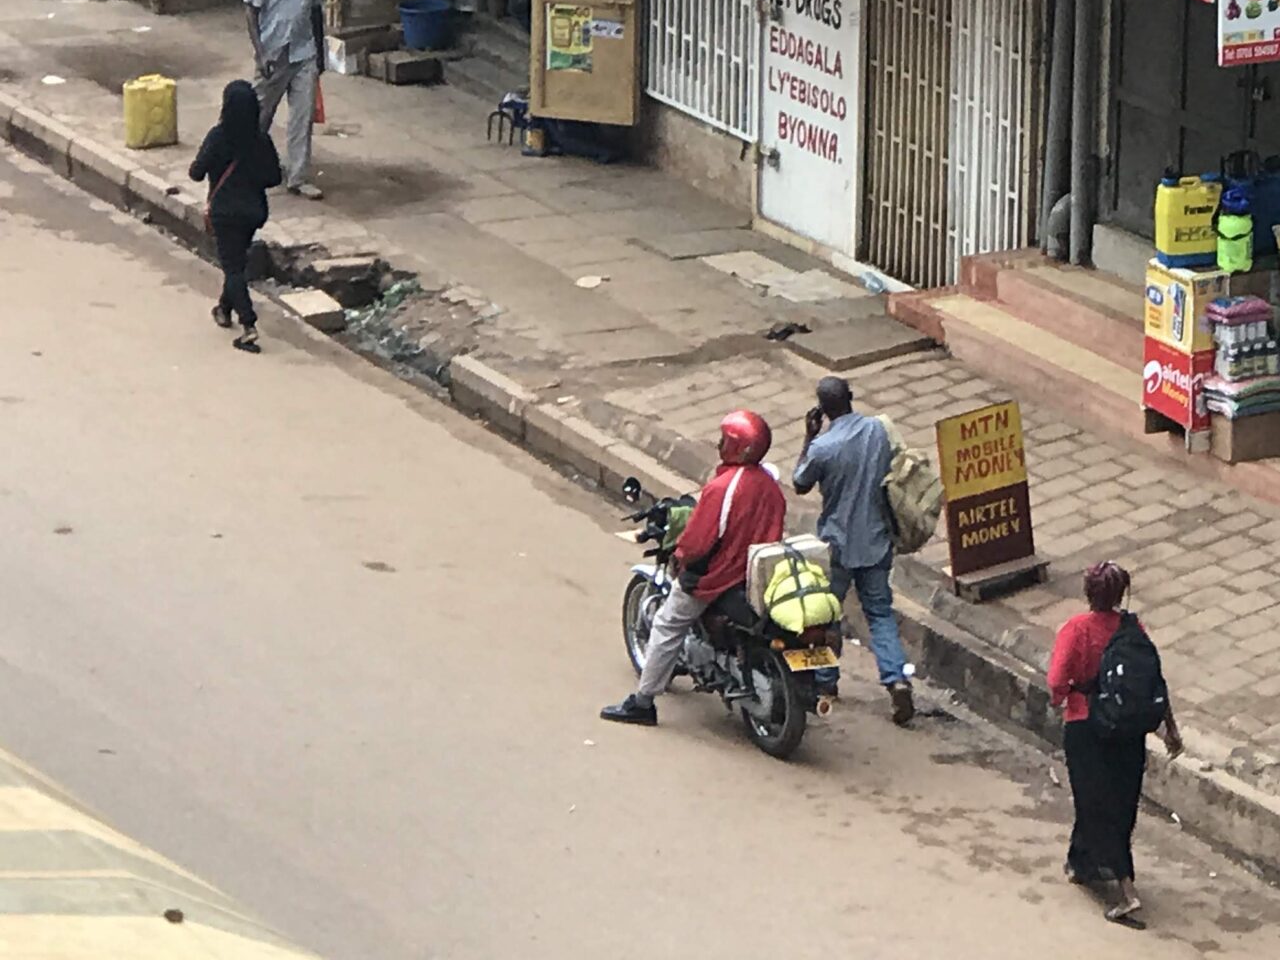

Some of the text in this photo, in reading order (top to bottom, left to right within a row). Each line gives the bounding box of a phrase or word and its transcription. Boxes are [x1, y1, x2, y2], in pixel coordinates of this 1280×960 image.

[769, 25, 844, 80] EDDAGALA
[959, 408, 1009, 442] MTN
[956, 433, 1016, 464] MOBILE
[955, 447, 1025, 485] MONEY
[957, 497, 1019, 528] AIRTEL
[961, 517, 1021, 549] MONEY
